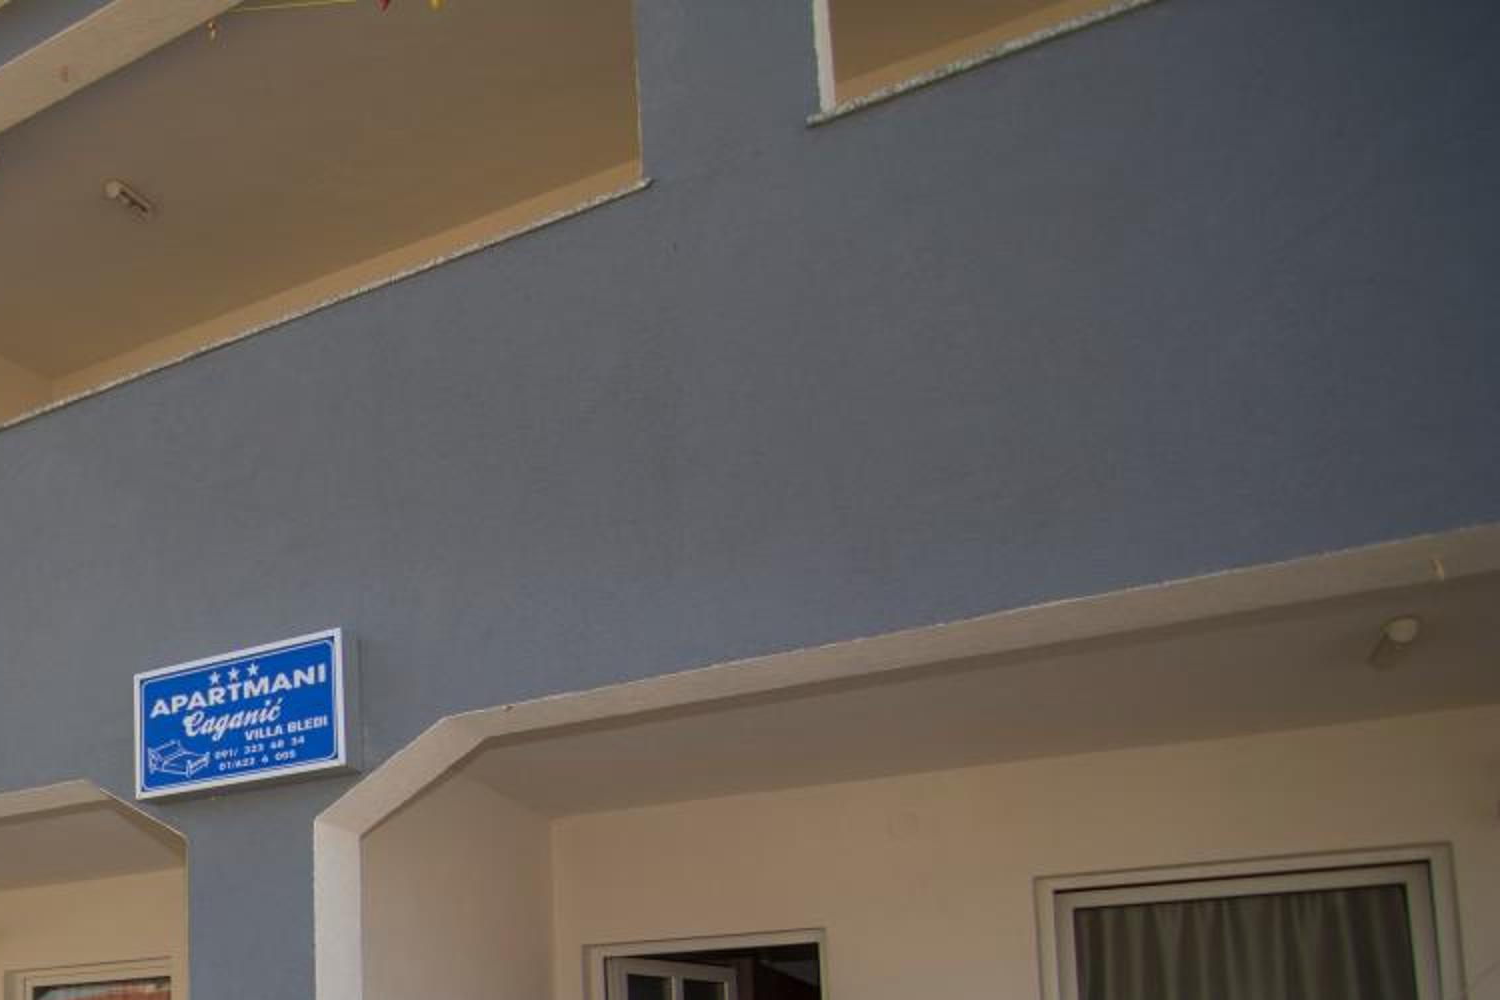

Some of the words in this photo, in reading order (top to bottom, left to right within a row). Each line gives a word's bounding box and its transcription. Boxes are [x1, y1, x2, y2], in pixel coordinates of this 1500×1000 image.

[150, 662, 327, 718] APARTMANI
[244, 723, 283, 741] VILLA
[287, 715, 328, 734] BLEDI
